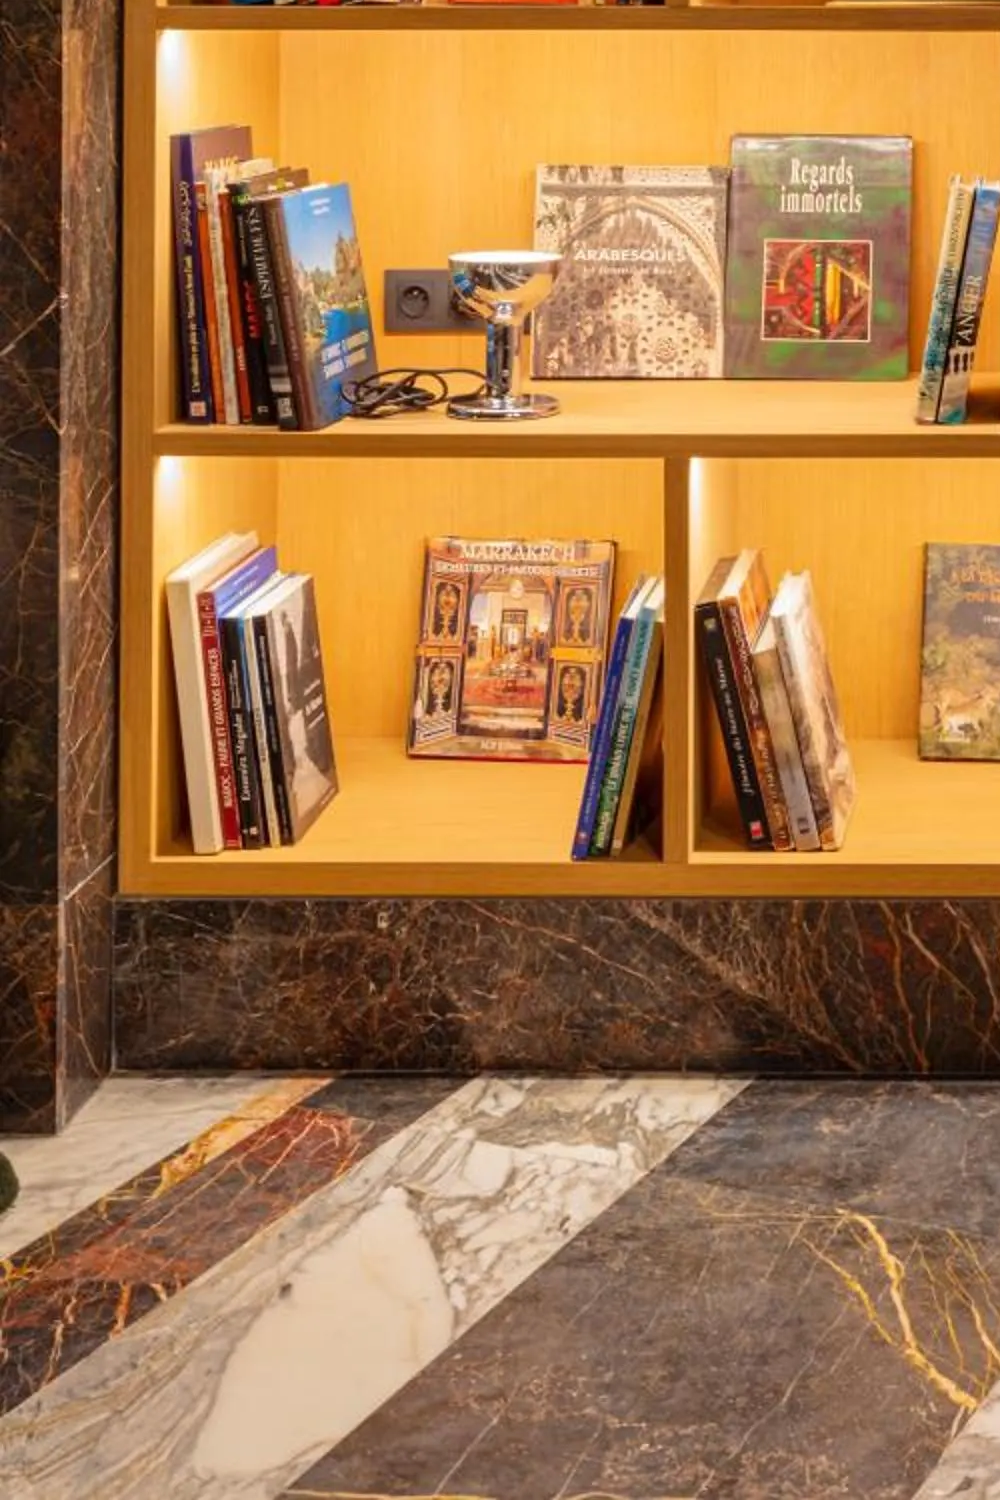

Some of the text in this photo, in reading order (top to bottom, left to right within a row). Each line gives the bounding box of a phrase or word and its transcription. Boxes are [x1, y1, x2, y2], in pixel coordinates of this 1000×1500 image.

[791, 156, 854, 192] Regards
[780, 185, 863, 213] immortels
[574, 248, 688, 262] ARABESQUES
[955, 273, 982, 348] TANGER
[460, 543, 576, 563] MARRAKECH
[211, 688, 225, 725] GRANDS
[219, 774, 234, 808] MAROC
